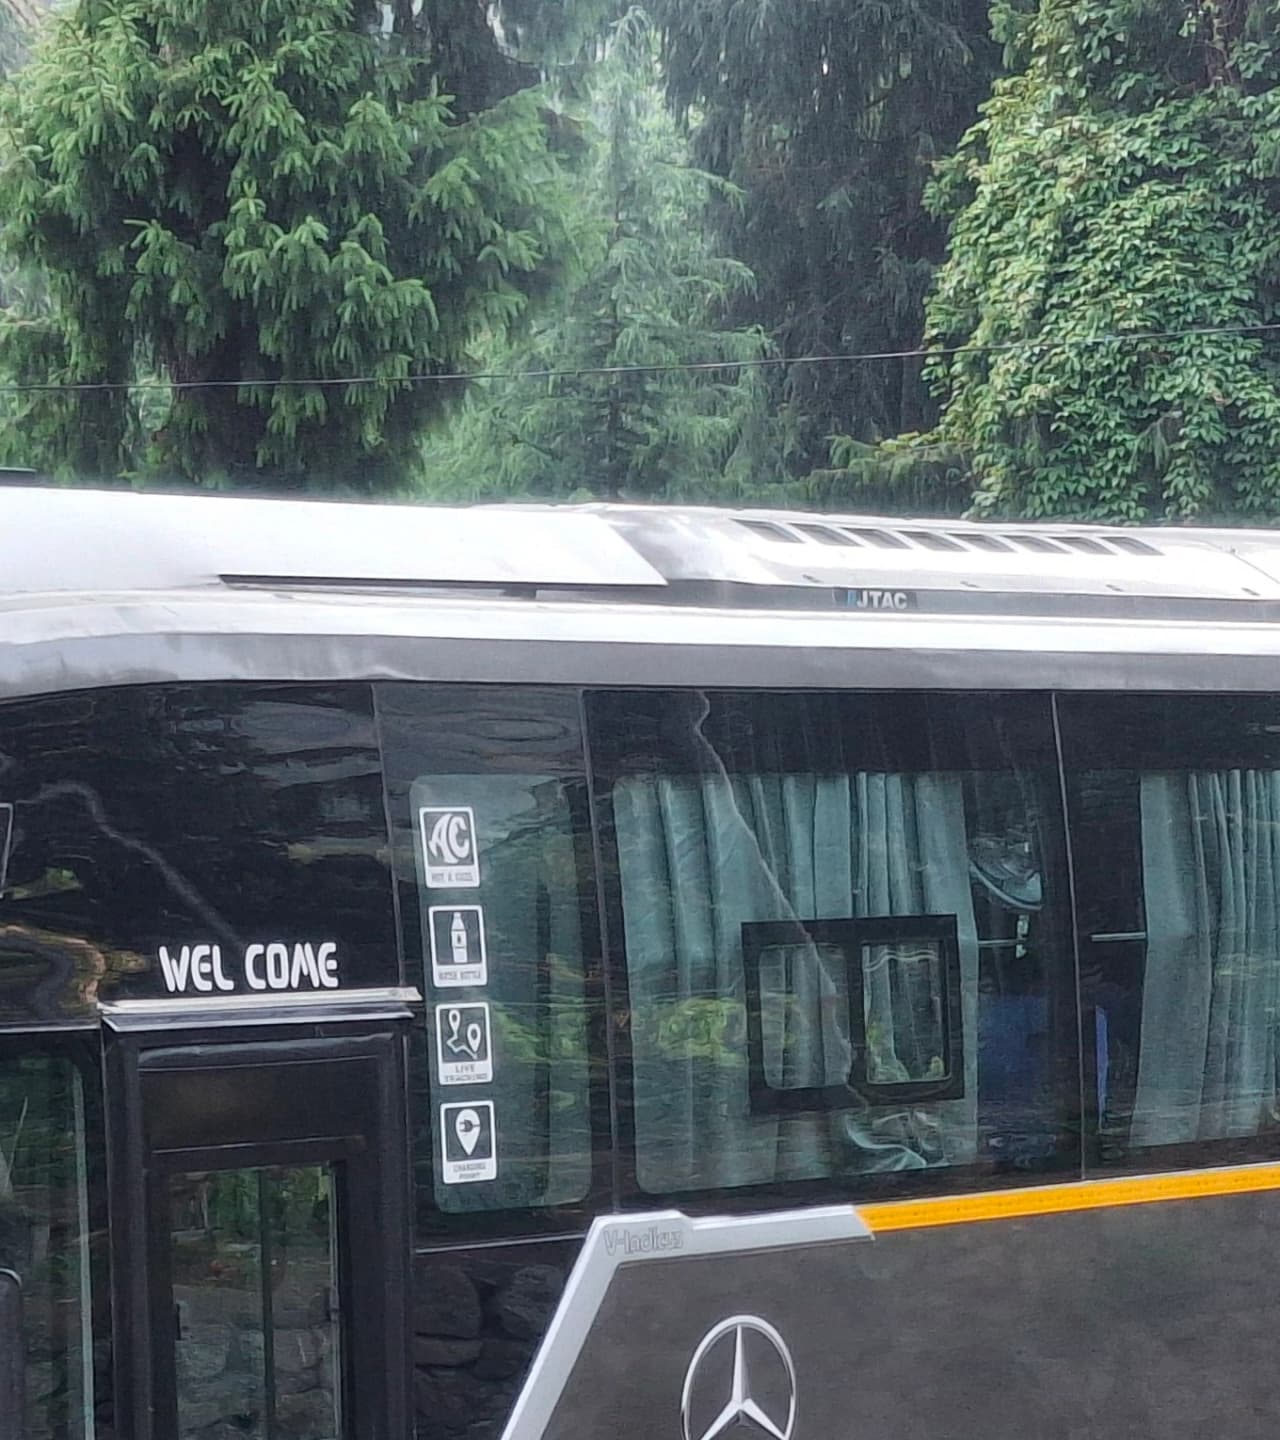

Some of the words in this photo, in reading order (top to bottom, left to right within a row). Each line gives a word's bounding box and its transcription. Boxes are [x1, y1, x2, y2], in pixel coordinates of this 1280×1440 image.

[429, 813, 470, 864] AC
[158, 944, 234, 992] WEL
[245, 942, 339, 990] COME
